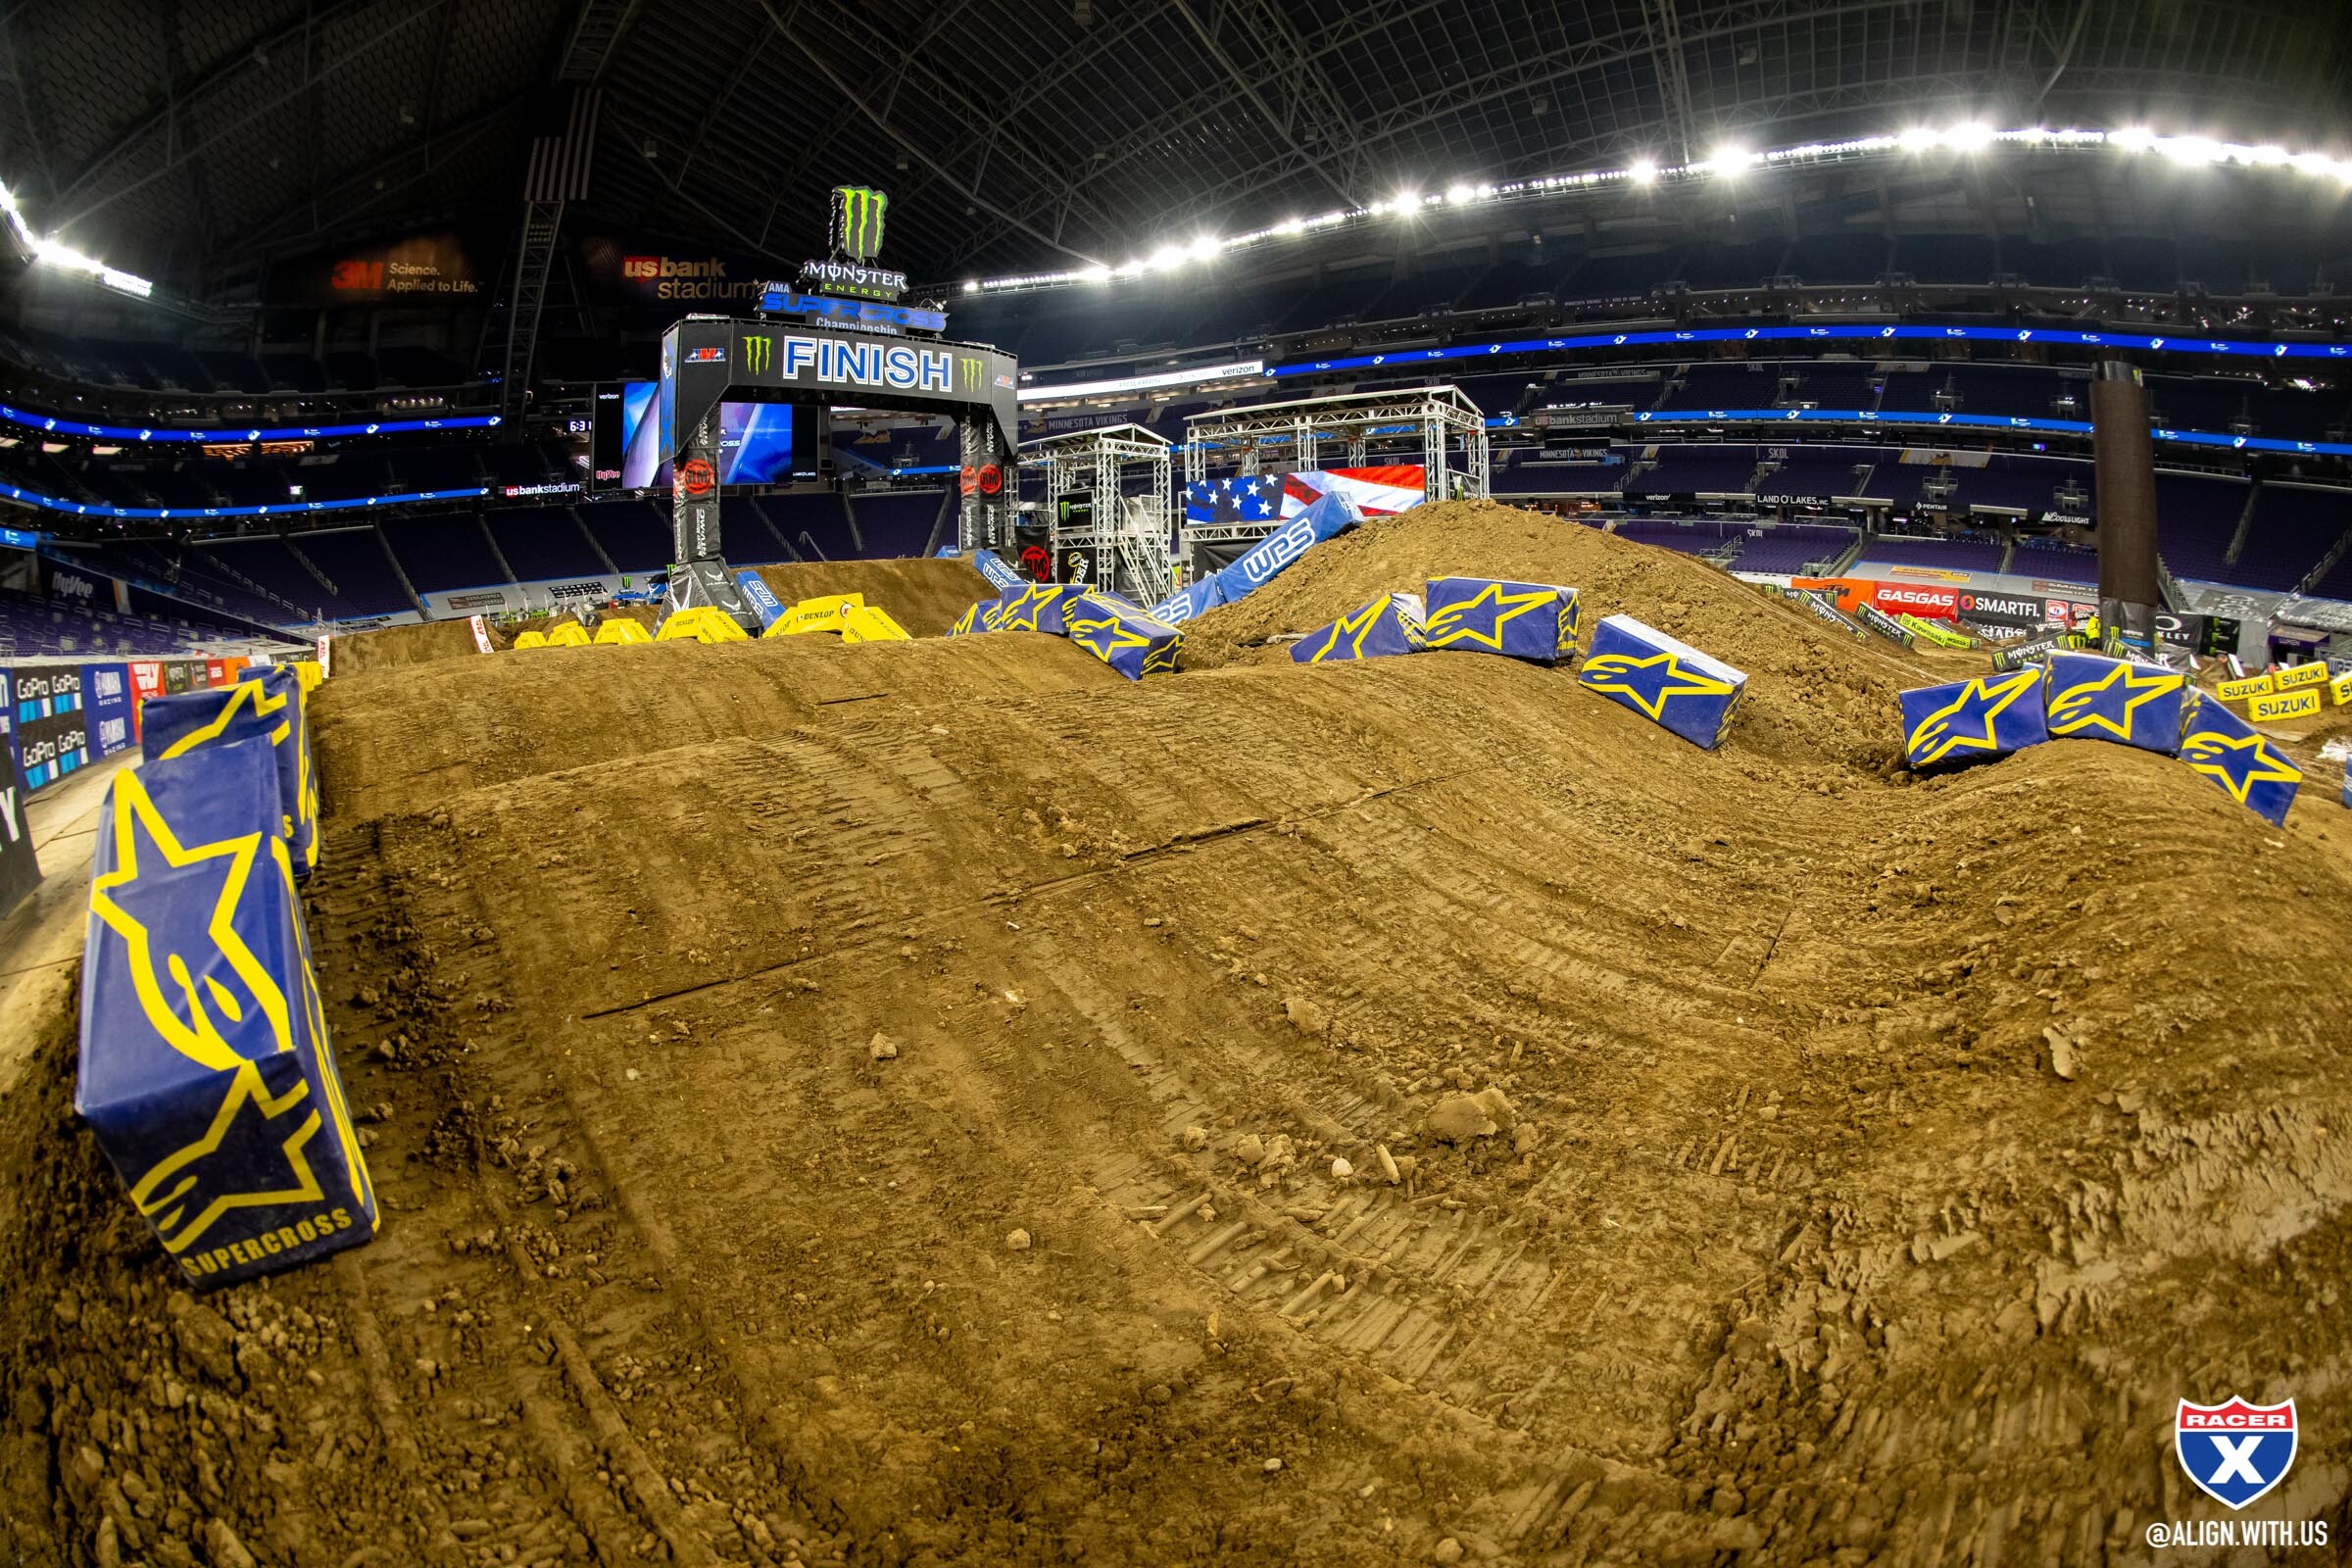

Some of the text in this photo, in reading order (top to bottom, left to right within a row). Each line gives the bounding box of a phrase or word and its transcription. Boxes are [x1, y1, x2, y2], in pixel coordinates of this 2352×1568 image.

[331, 261, 384, 290] 3M
[389, 263, 440, 275] Science.
[809, 262, 907, 291] MONSTER
[387, 279, 478, 293] Applied to Life.
[658, 278, 756, 299] stadium
[768, 282, 790, 294] AMA
[824, 283, 893, 297] ENERGY
[760, 294, 947, 331] SUPERCROSS
[685, 348, 726, 363] AMA
[783, 335, 953, 393] FINISH
[1222, 364, 1255, 376] verizon
[1747, 363, 1764, 372] SKOL
[1049, 414, 1128, 430] MINNESOTA VIKINGS
[1540, 448, 1607, 460] MINNESOTA VIKINGS
[1769, 448, 1788, 460] SKOL
[1757, 495, 1780, 504] LAND
[1243, 517, 1315, 582] WPS
[990, 558, 1021, 581] WPS
[1877, 589, 1954, 607] GASGAS
[1975, 597, 2040, 617] SMARTFI.
[804, 611, 834, 620] DUNLOP
[1150, 593, 1193, 624] PS
[1867, 612, 1902, 637] MONSTER
[1911, 621, 1945, 643] Kawasaki
[2157, 631, 2189, 640] KLEY
[2007, 640, 2055, 660] MONSTER
[2281, 666, 2325, 686] SUZUKI
[17, 673, 80, 699] GoPro GoPro
[2223, 680, 2270, 698] SUZUKI
[2258, 697, 2316, 716] SUZUKI
[23, 730, 85, 767] GoPro GoPro
[180, 1207, 352, 1277] SUPERCROSS
